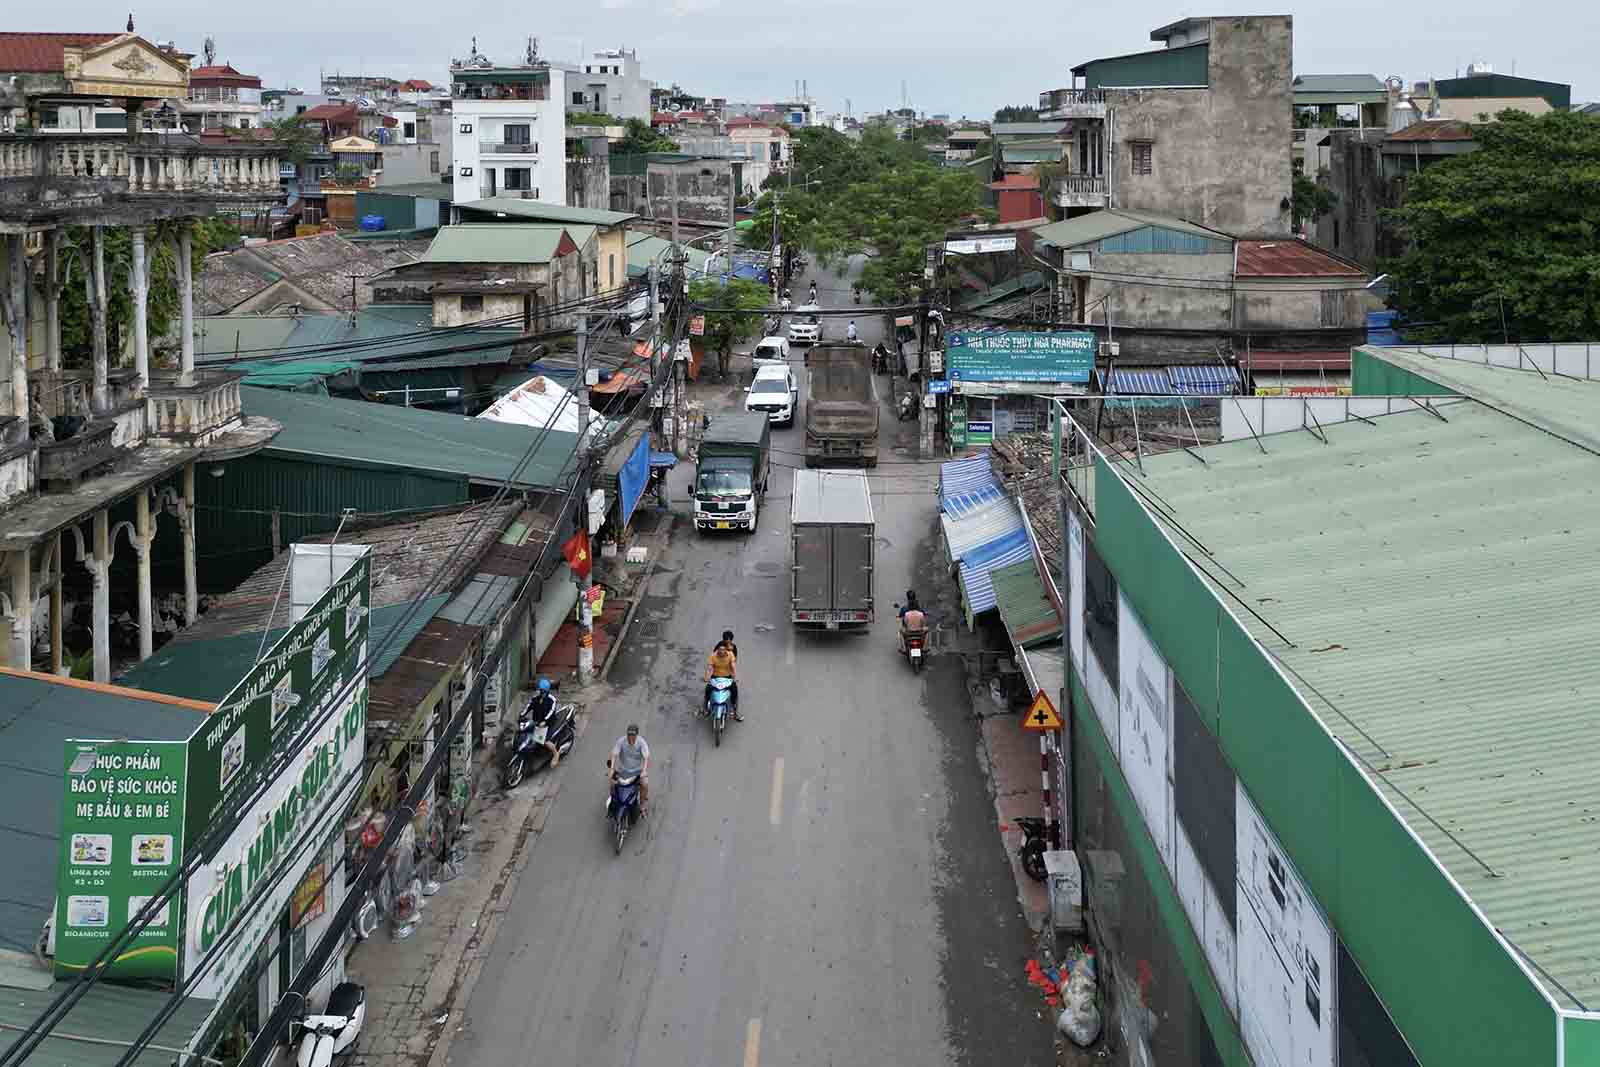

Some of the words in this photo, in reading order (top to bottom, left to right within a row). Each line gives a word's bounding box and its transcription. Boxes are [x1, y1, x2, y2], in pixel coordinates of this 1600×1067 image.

[1051, 337, 1093, 349] PHARMACY
[206, 711, 232, 752] THỰC
[259, 663, 276, 696] BẢO
[92, 753, 123, 774] HỰC
[125, 748, 161, 770] PHẨM
[71, 775, 97, 793] BẢO
[100, 777, 114, 797] VỆ
[117, 777, 142, 794] SỨC
[76, 803, 94, 821] MẸ
[96, 797, 120, 817] BẦU
[123, 804, 133, 818] &
[136, 804, 152, 818] EM
[156, 801, 169, 818] BÉ
[198, 862, 242, 952] CỬA
[244, 783, 298, 894] HÀNG
